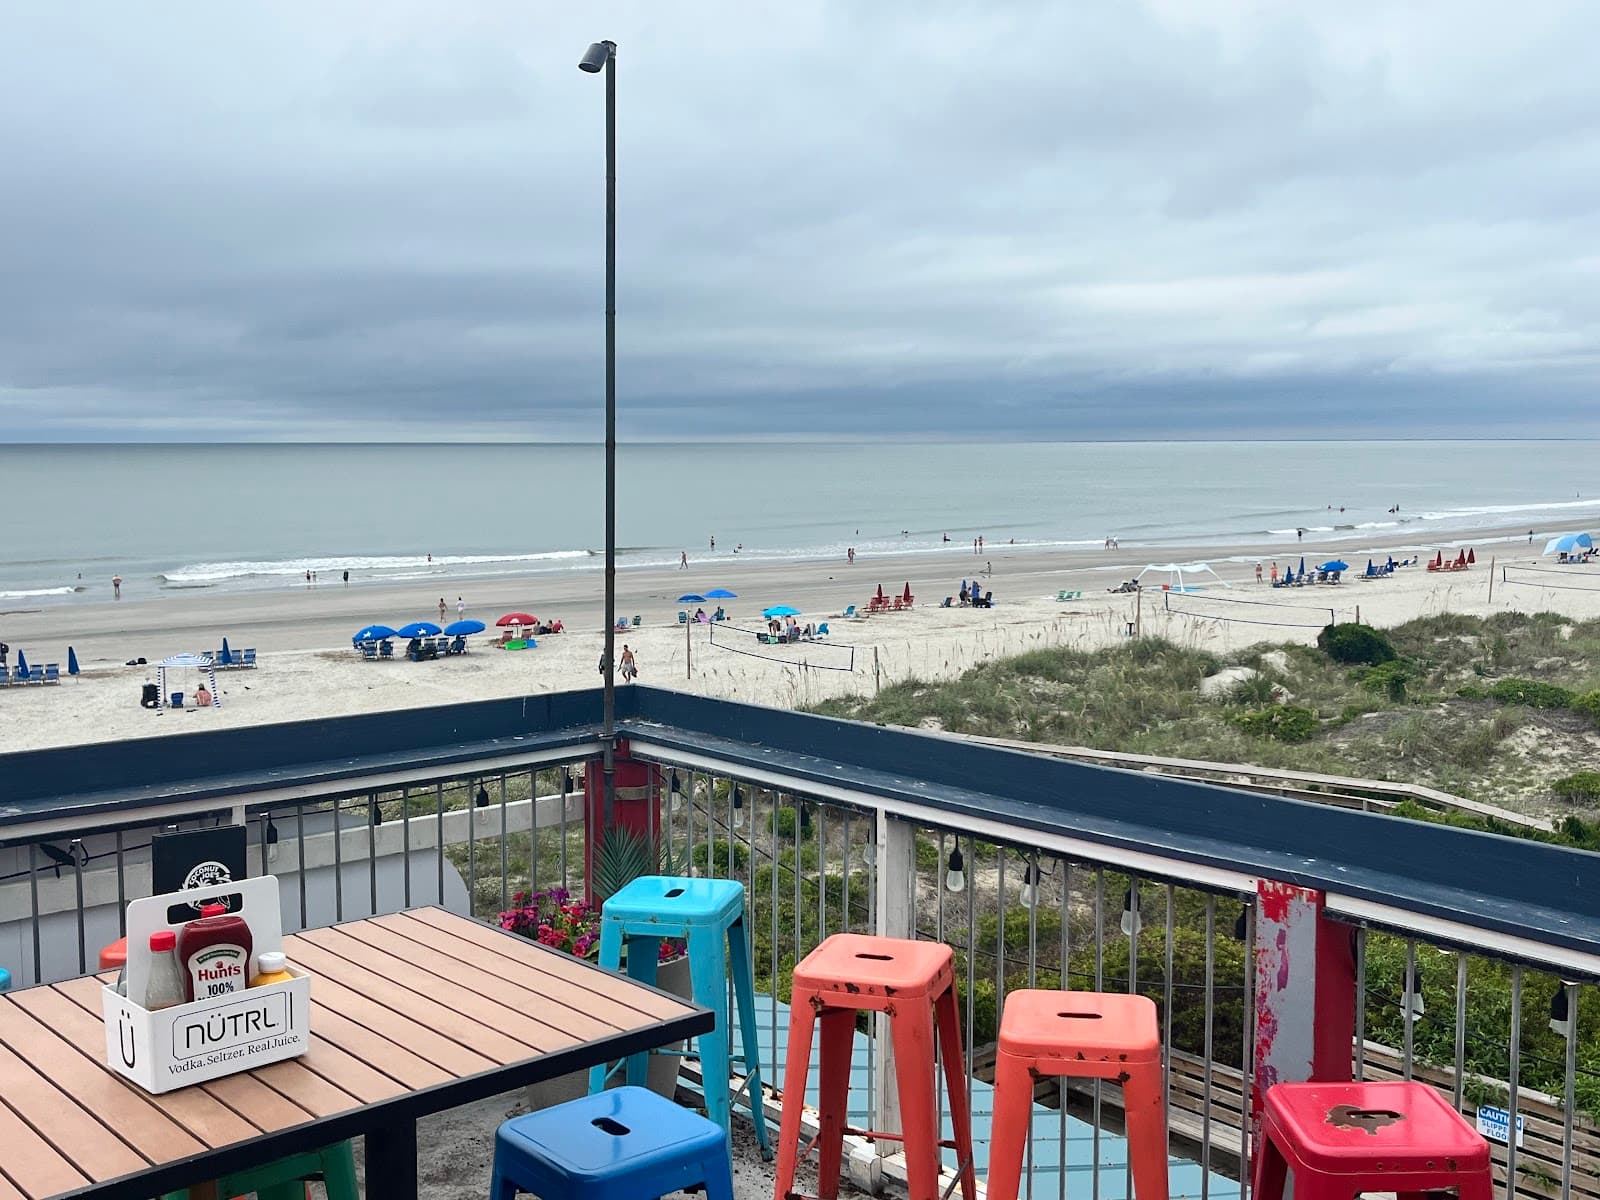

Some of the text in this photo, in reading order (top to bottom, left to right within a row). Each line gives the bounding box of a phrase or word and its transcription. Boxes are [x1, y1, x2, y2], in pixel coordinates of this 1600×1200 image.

[190, 866, 219, 885] COCONUT
[198, 963, 241, 981] Hunt's
[207, 981, 234, 995] 100%
[119, 1009, 135, 1069] Ü
[168, 1035, 301, 1075] Vodka. Seltzer. Real Juice.
[1486, 1129, 1507, 1140] FLOO
